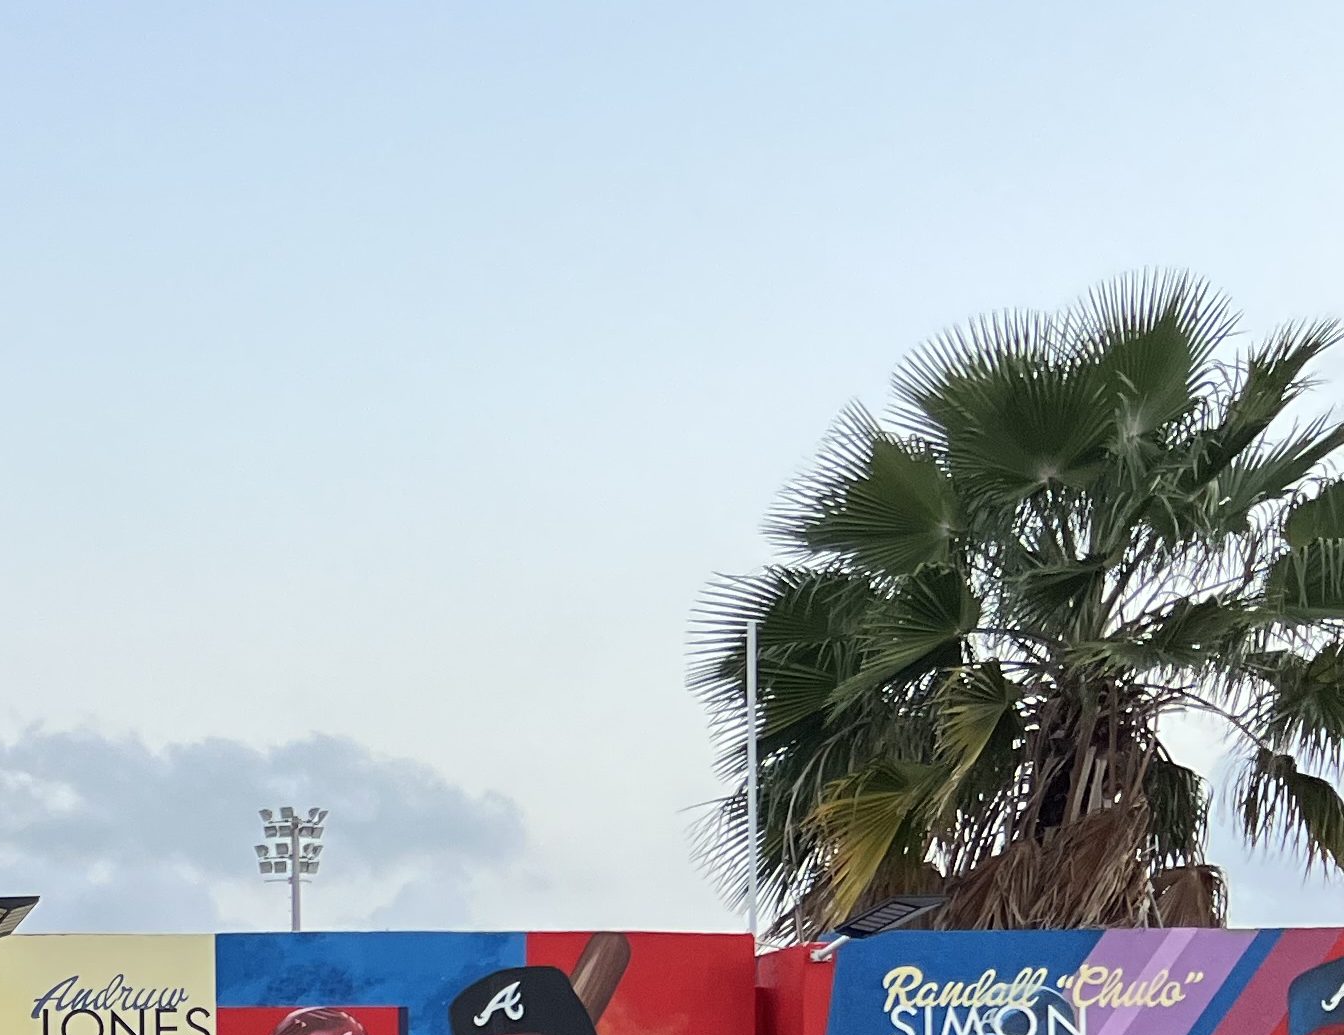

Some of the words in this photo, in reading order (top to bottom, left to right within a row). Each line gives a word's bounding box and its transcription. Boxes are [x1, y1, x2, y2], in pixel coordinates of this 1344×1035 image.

[30, 974, 190, 1019] Andruw
[883, 966, 1048, 1013] Randall
[1056, 964, 1204, 1009] "Chulo"
